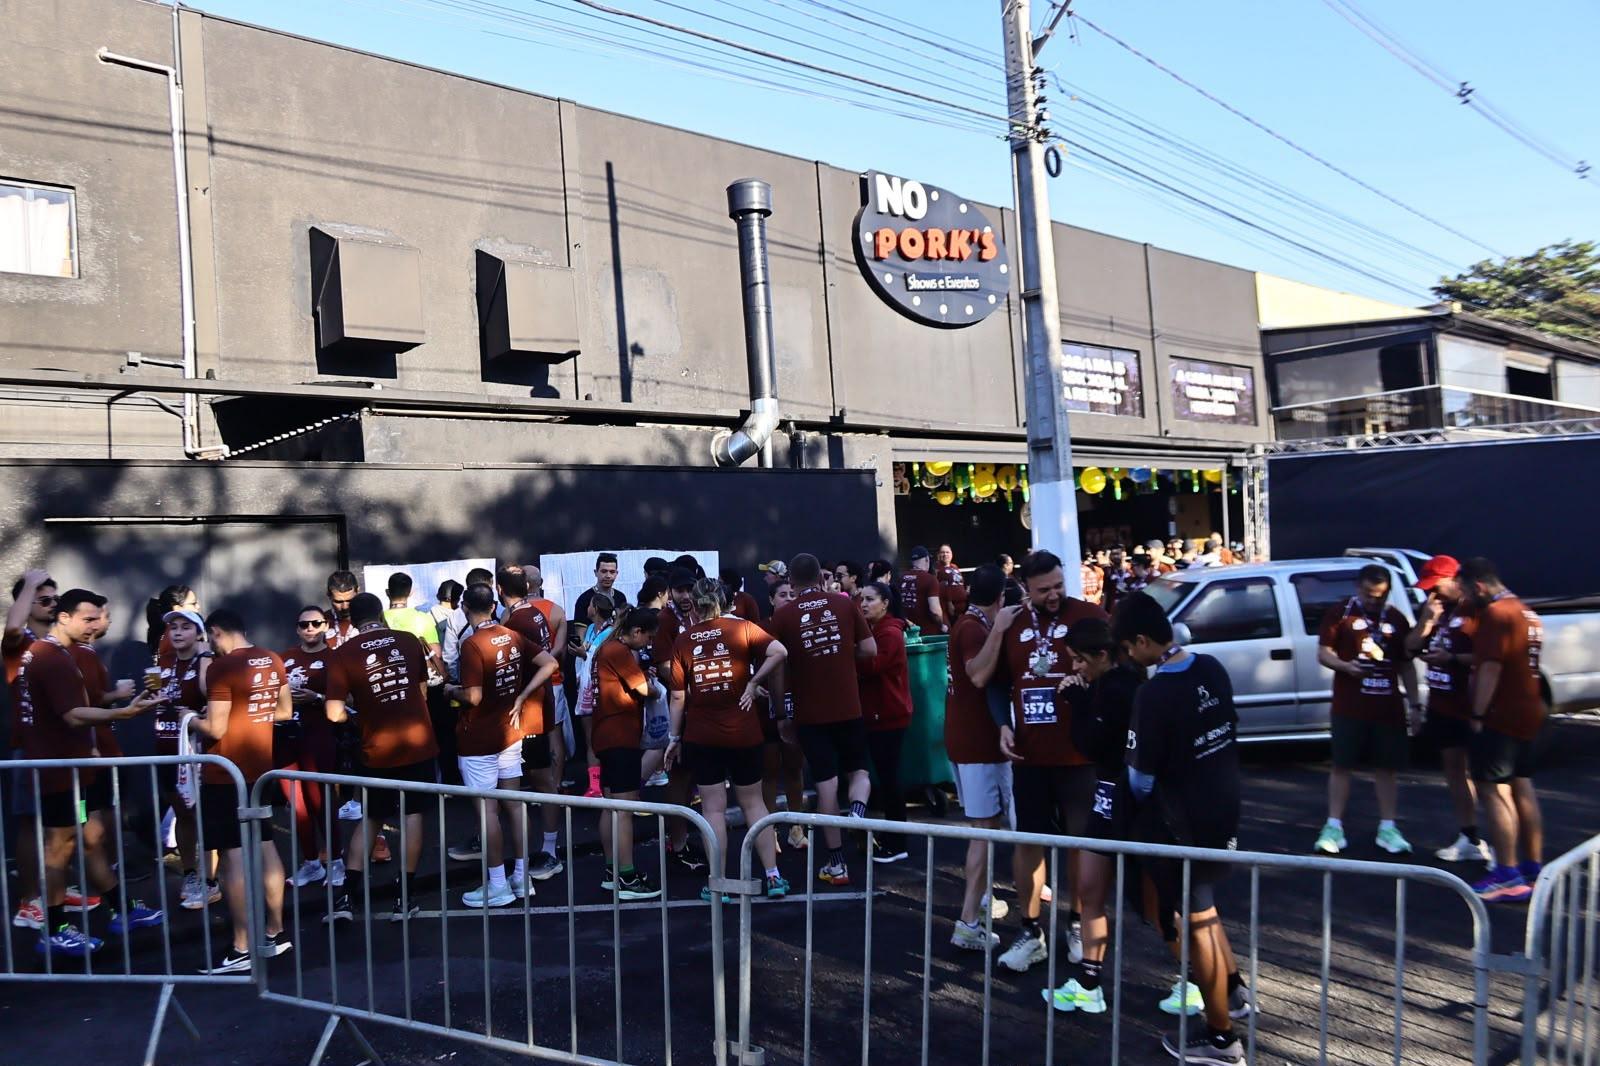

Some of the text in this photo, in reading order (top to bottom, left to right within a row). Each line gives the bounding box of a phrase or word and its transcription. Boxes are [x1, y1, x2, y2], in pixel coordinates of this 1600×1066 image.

[875, 174, 928, 220] NO
[875, 227, 998, 263] PORK'S
[798, 598, 829, 609] CROSS
[690, 628, 722, 640] CROSS
[360, 636, 396, 649] CROSS
[1023, 701, 1055, 715] 5576
